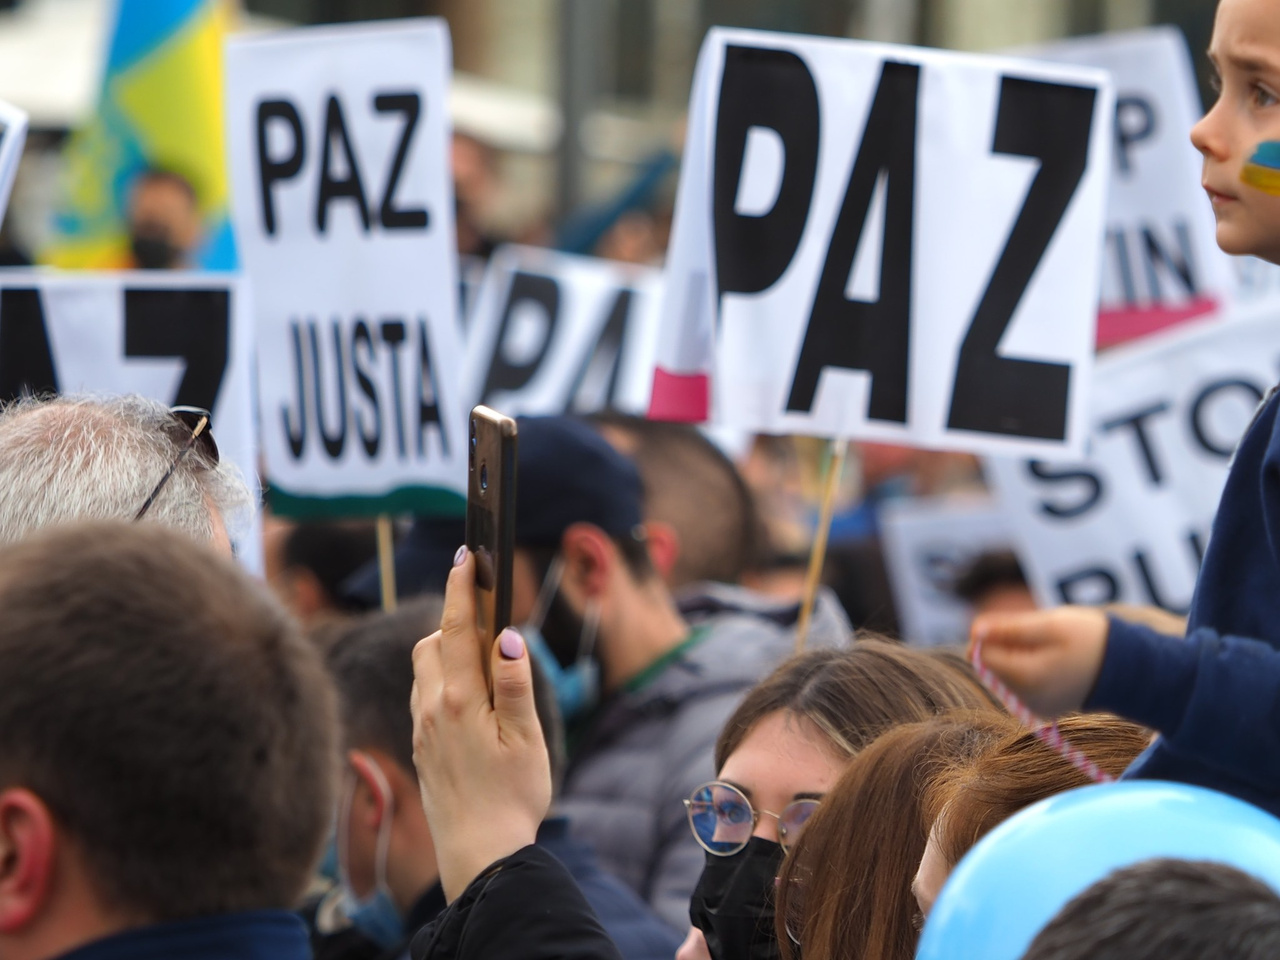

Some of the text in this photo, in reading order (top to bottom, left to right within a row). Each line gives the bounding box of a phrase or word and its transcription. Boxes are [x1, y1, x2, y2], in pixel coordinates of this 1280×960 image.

[256, 88, 428, 235] PAZ
[713, 43, 1100, 442] PAZ
[281, 314, 452, 463] JUSTA
